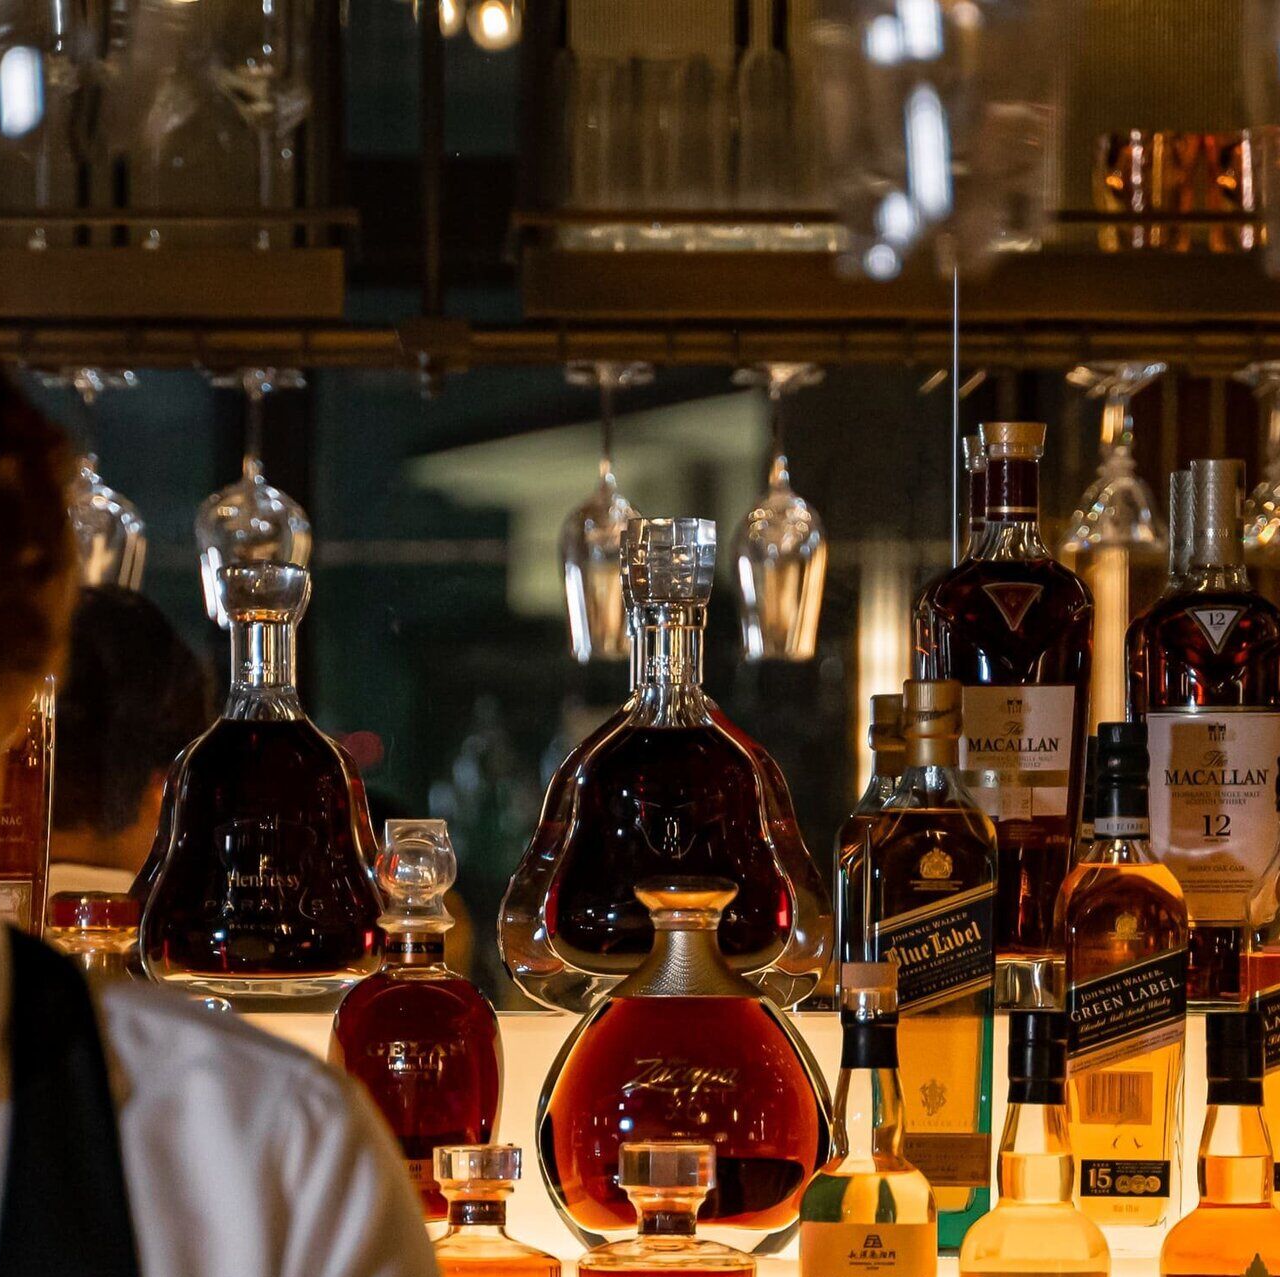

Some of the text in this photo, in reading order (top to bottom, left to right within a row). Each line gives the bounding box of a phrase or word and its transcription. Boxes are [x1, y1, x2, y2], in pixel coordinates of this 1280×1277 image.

[1208, 612, 1226, 626] 12
[969, 738, 1059, 752] MACALLAN
[1164, 769, 1269, 786] MACALLAN
[1202, 814, 1232, 837] 12
[884, 921, 982, 968] Blue Label
[1070, 977, 1180, 1023] GREEN LABEL
[1088, 1168, 1112, 1188] 15
